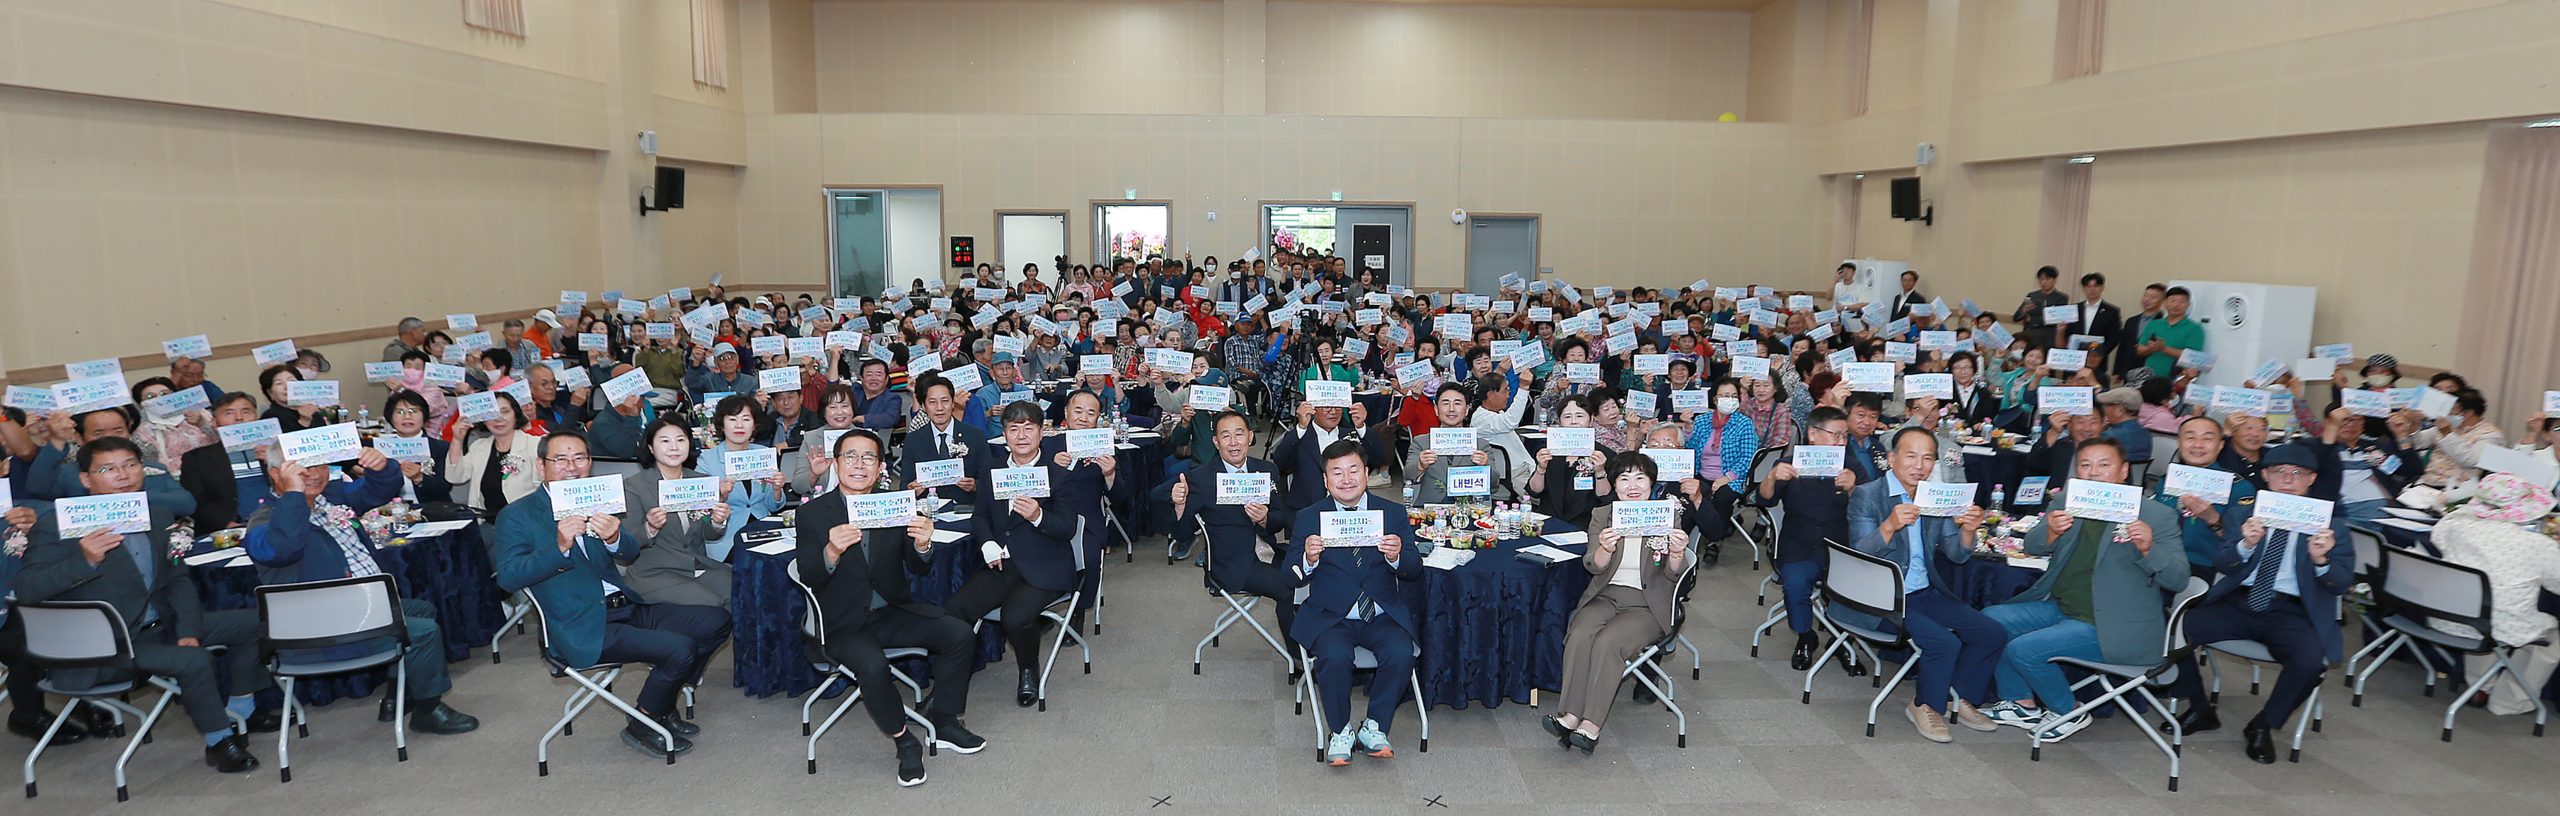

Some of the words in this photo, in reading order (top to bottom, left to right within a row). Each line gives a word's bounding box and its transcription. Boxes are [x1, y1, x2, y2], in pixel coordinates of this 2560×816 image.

[750, 461, 768, 469] 함평읍
[1025, 479, 1046, 487] 함평읍
[1453, 478, 1484, 489] 내빈석
[1241, 486, 1261, 494] 함평읍
[575, 494, 602, 505] 함평읍
[883, 506, 908, 515] 함평읍
[1644, 516, 1666, 524] 함평읍
[1340, 527, 1363, 535] 함평읍
